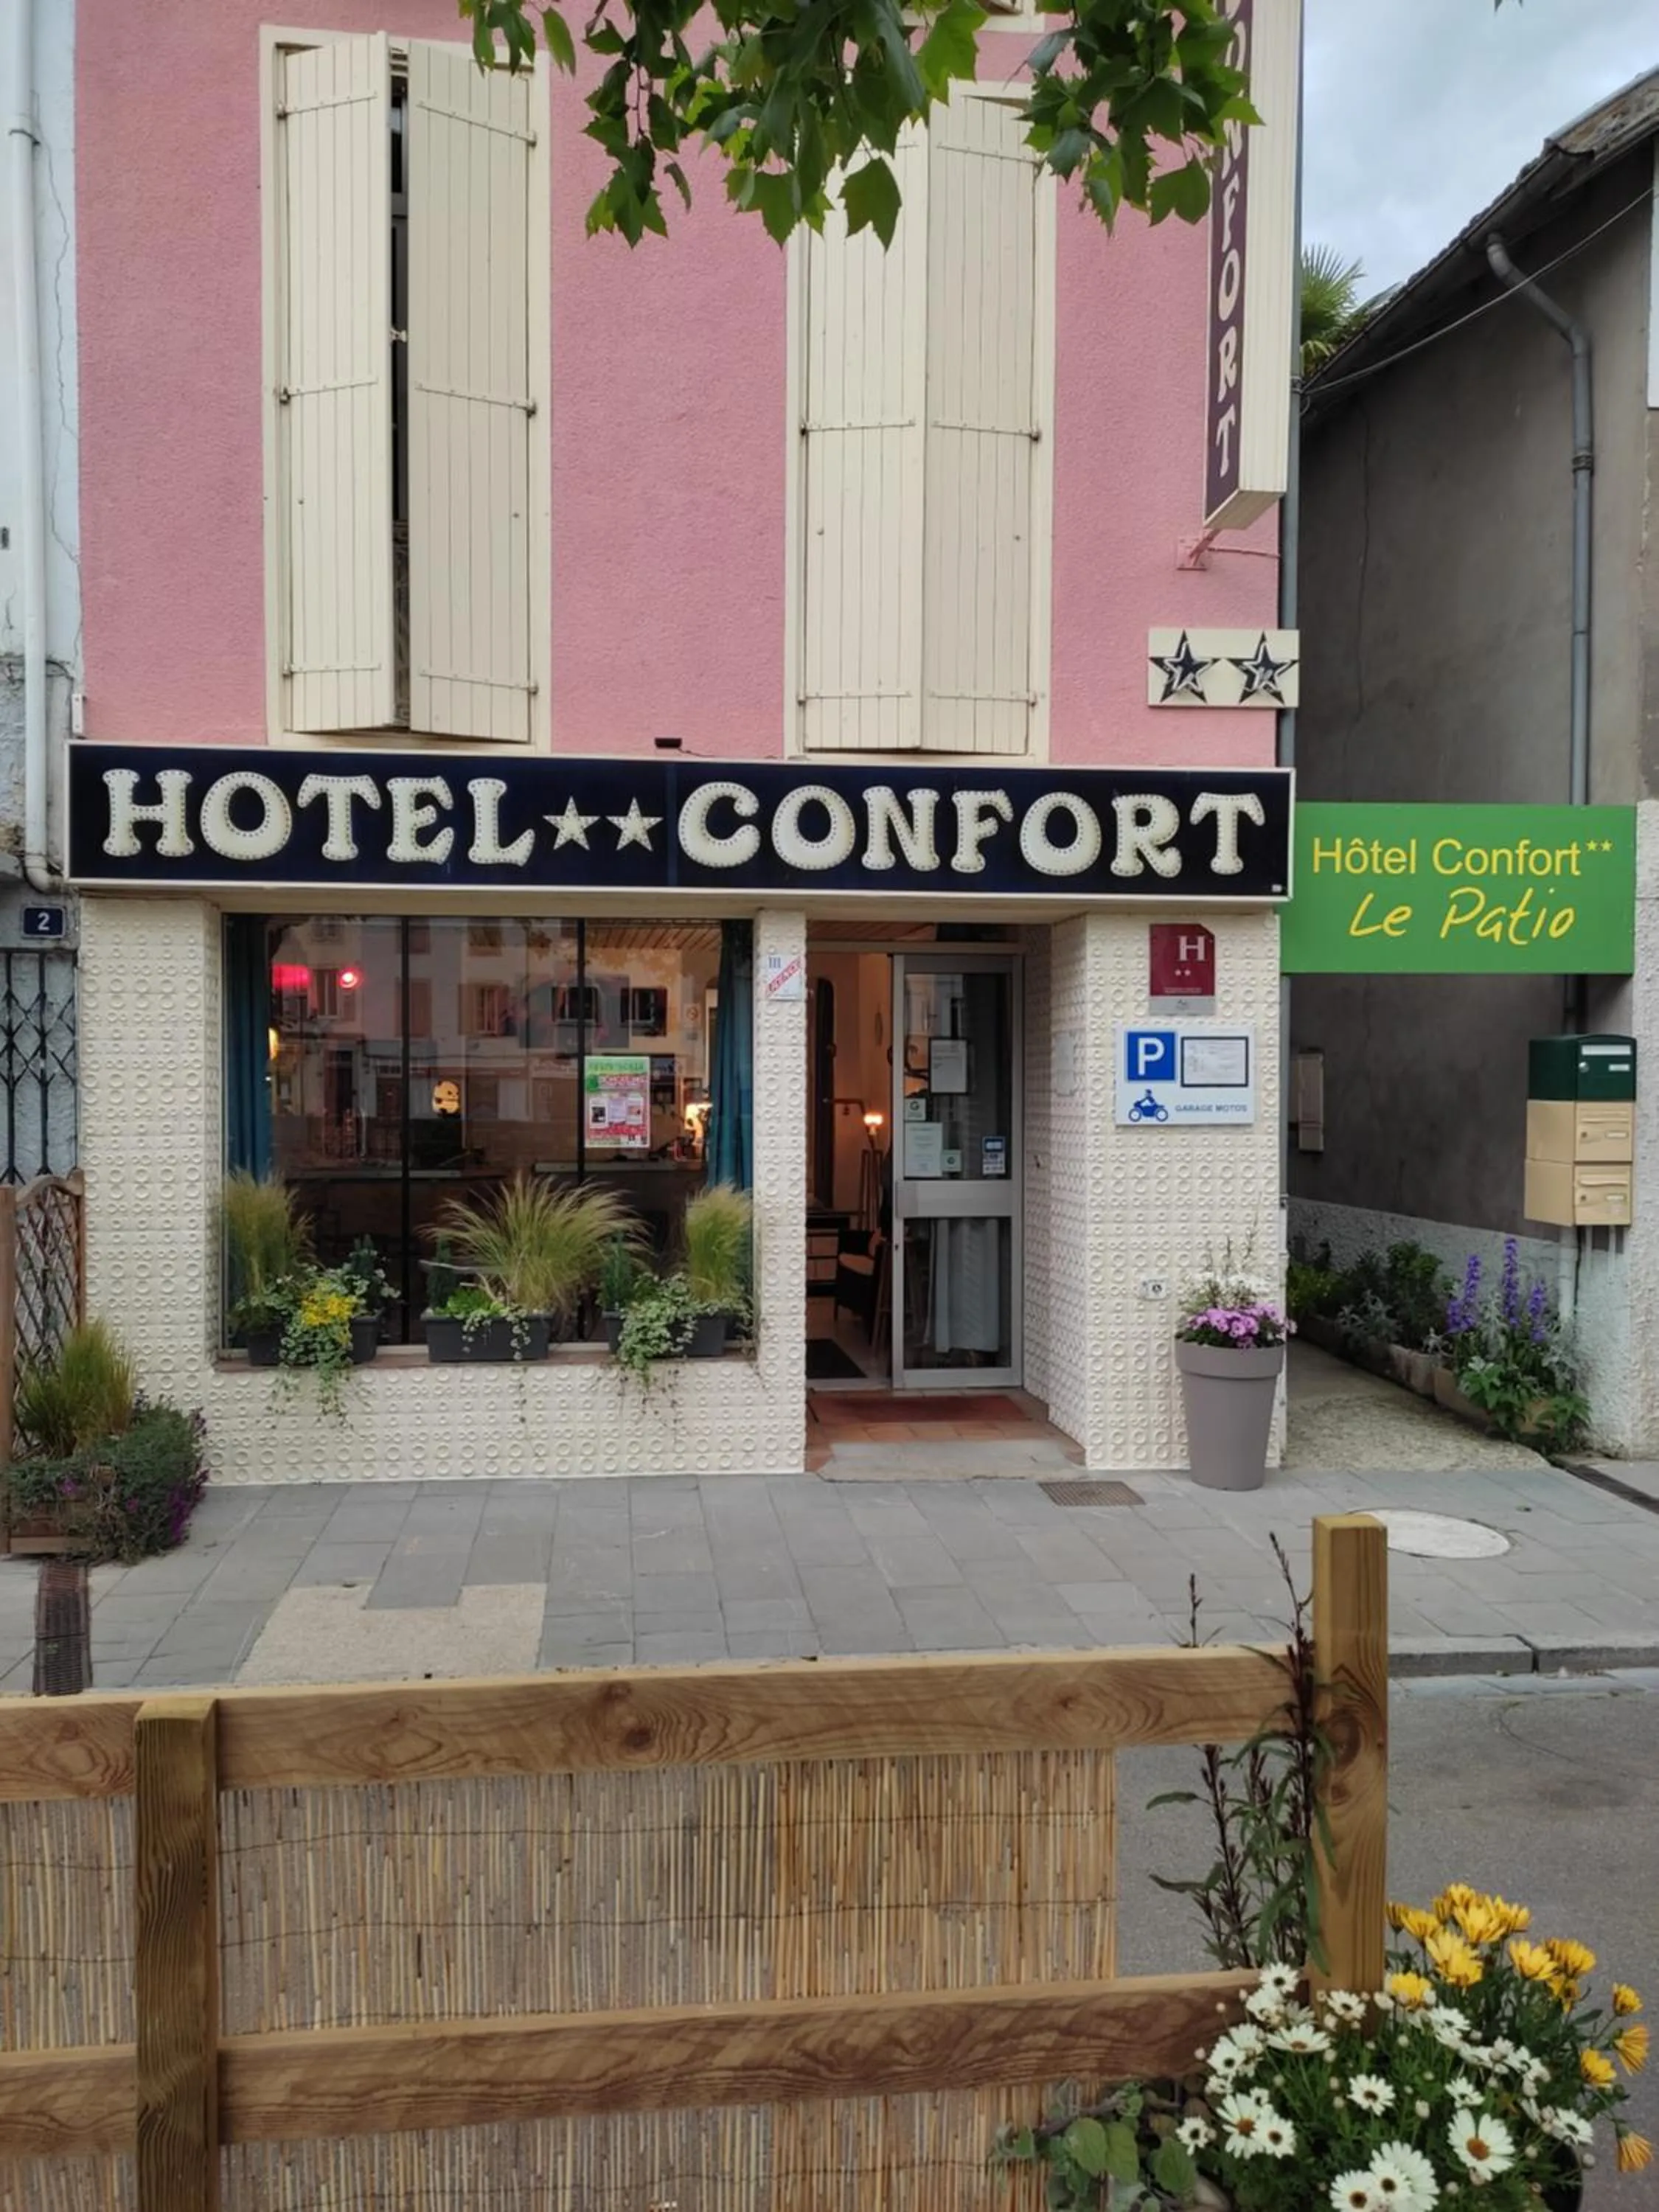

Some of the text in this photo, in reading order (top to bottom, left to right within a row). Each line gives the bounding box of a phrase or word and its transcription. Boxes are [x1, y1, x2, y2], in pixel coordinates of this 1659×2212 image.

[1216, 0, 1246, 478] ONFORT
[102, 768, 1265, 877] HOTEL CONFORT
[1313, 838, 1582, 875] Hôtel Confort
[38, 912, 49, 931] 2
[1349, 887, 1576, 945] Le Patio
[1178, 936, 1206, 961] H
[1138, 1037, 1165, 1077] P
